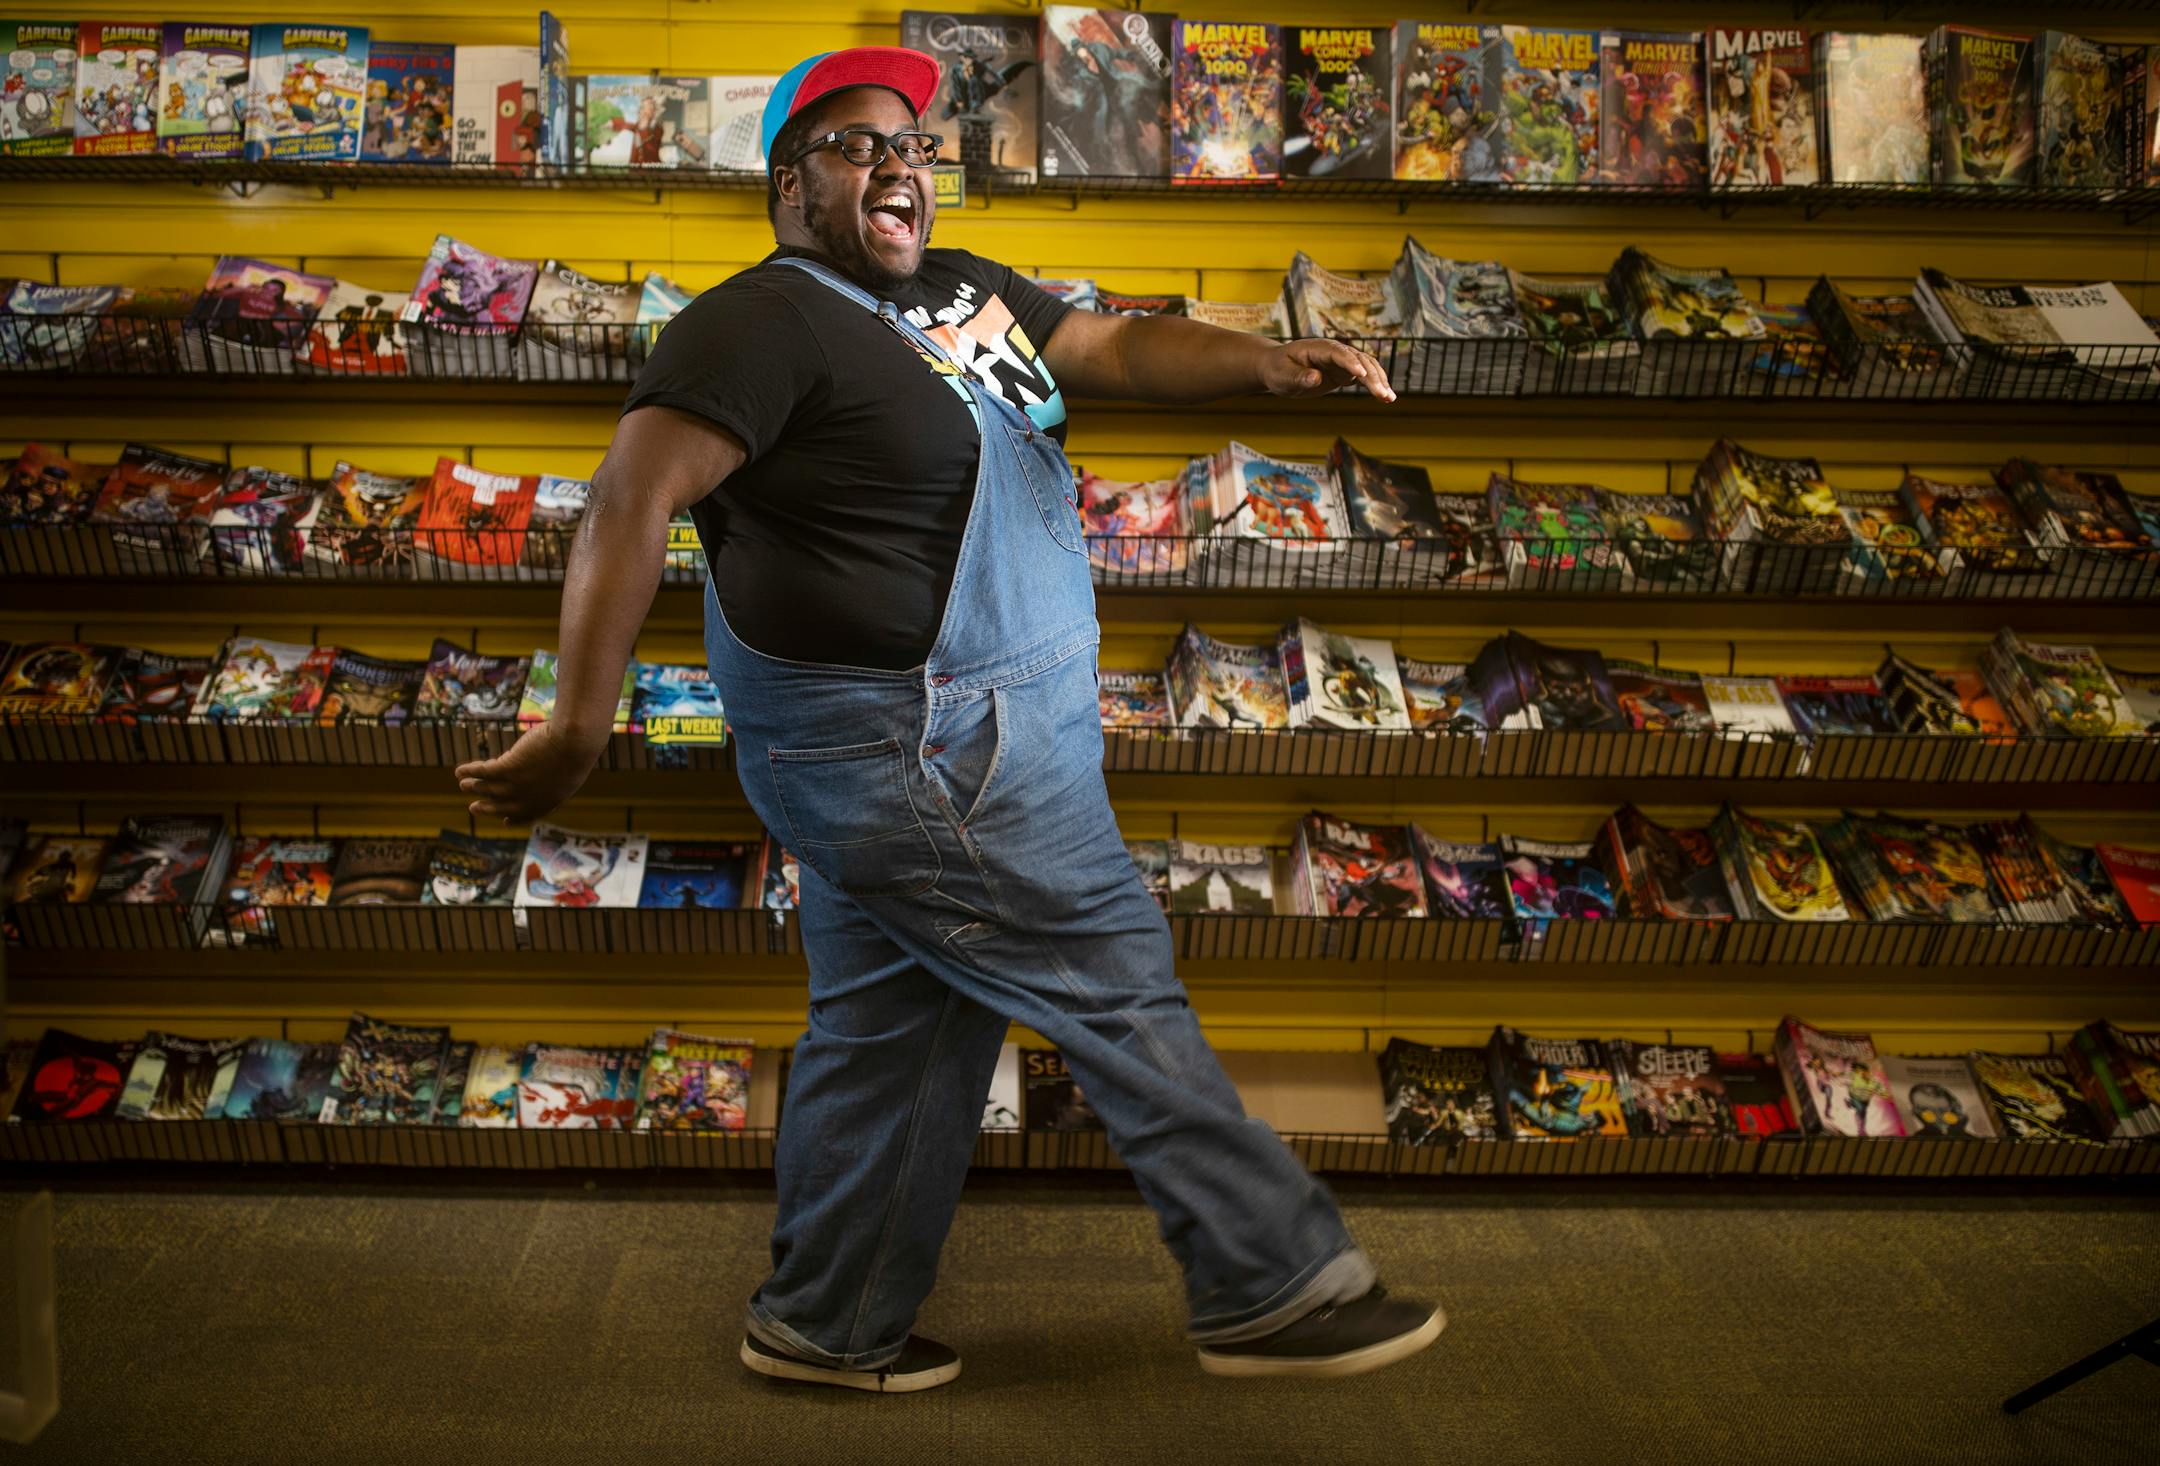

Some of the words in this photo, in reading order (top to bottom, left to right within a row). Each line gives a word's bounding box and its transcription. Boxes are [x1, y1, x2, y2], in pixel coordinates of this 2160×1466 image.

[184, 27, 249, 46] GARFIELD'S
[283, 28, 348, 48] GARFIELD'S
[1183, 23, 1268, 49] MARVEL
[1300, 29, 1374, 50] MARVEL
[1418, 23, 1479, 45] MARVEL
[1714, 28, 1804, 60] MARVEL
[1198, 43, 1254, 59] COMICS
[1312, 46, 1362, 60] COMICS
[1513, 30, 1598, 60] MARVEL
[1626, 41, 1699, 63] MARVEL
[1960, 36, 2018, 63] MARVEL
[1970, 54, 2006, 70] COMICS
[458, 118, 476, 129] GO
[458, 130, 486, 140] WITH
[457, 142, 477, 152] THE
[456, 153, 492, 165] FLOW
[333, 656, 425, 684] MOONSHINE
[646, 718, 678, 736] LAST
[680, 717, 722, 735] WEEK!
[1182, 844, 1266, 866] RAGS
[1637, 1047, 1711, 1081] STEEPLE
